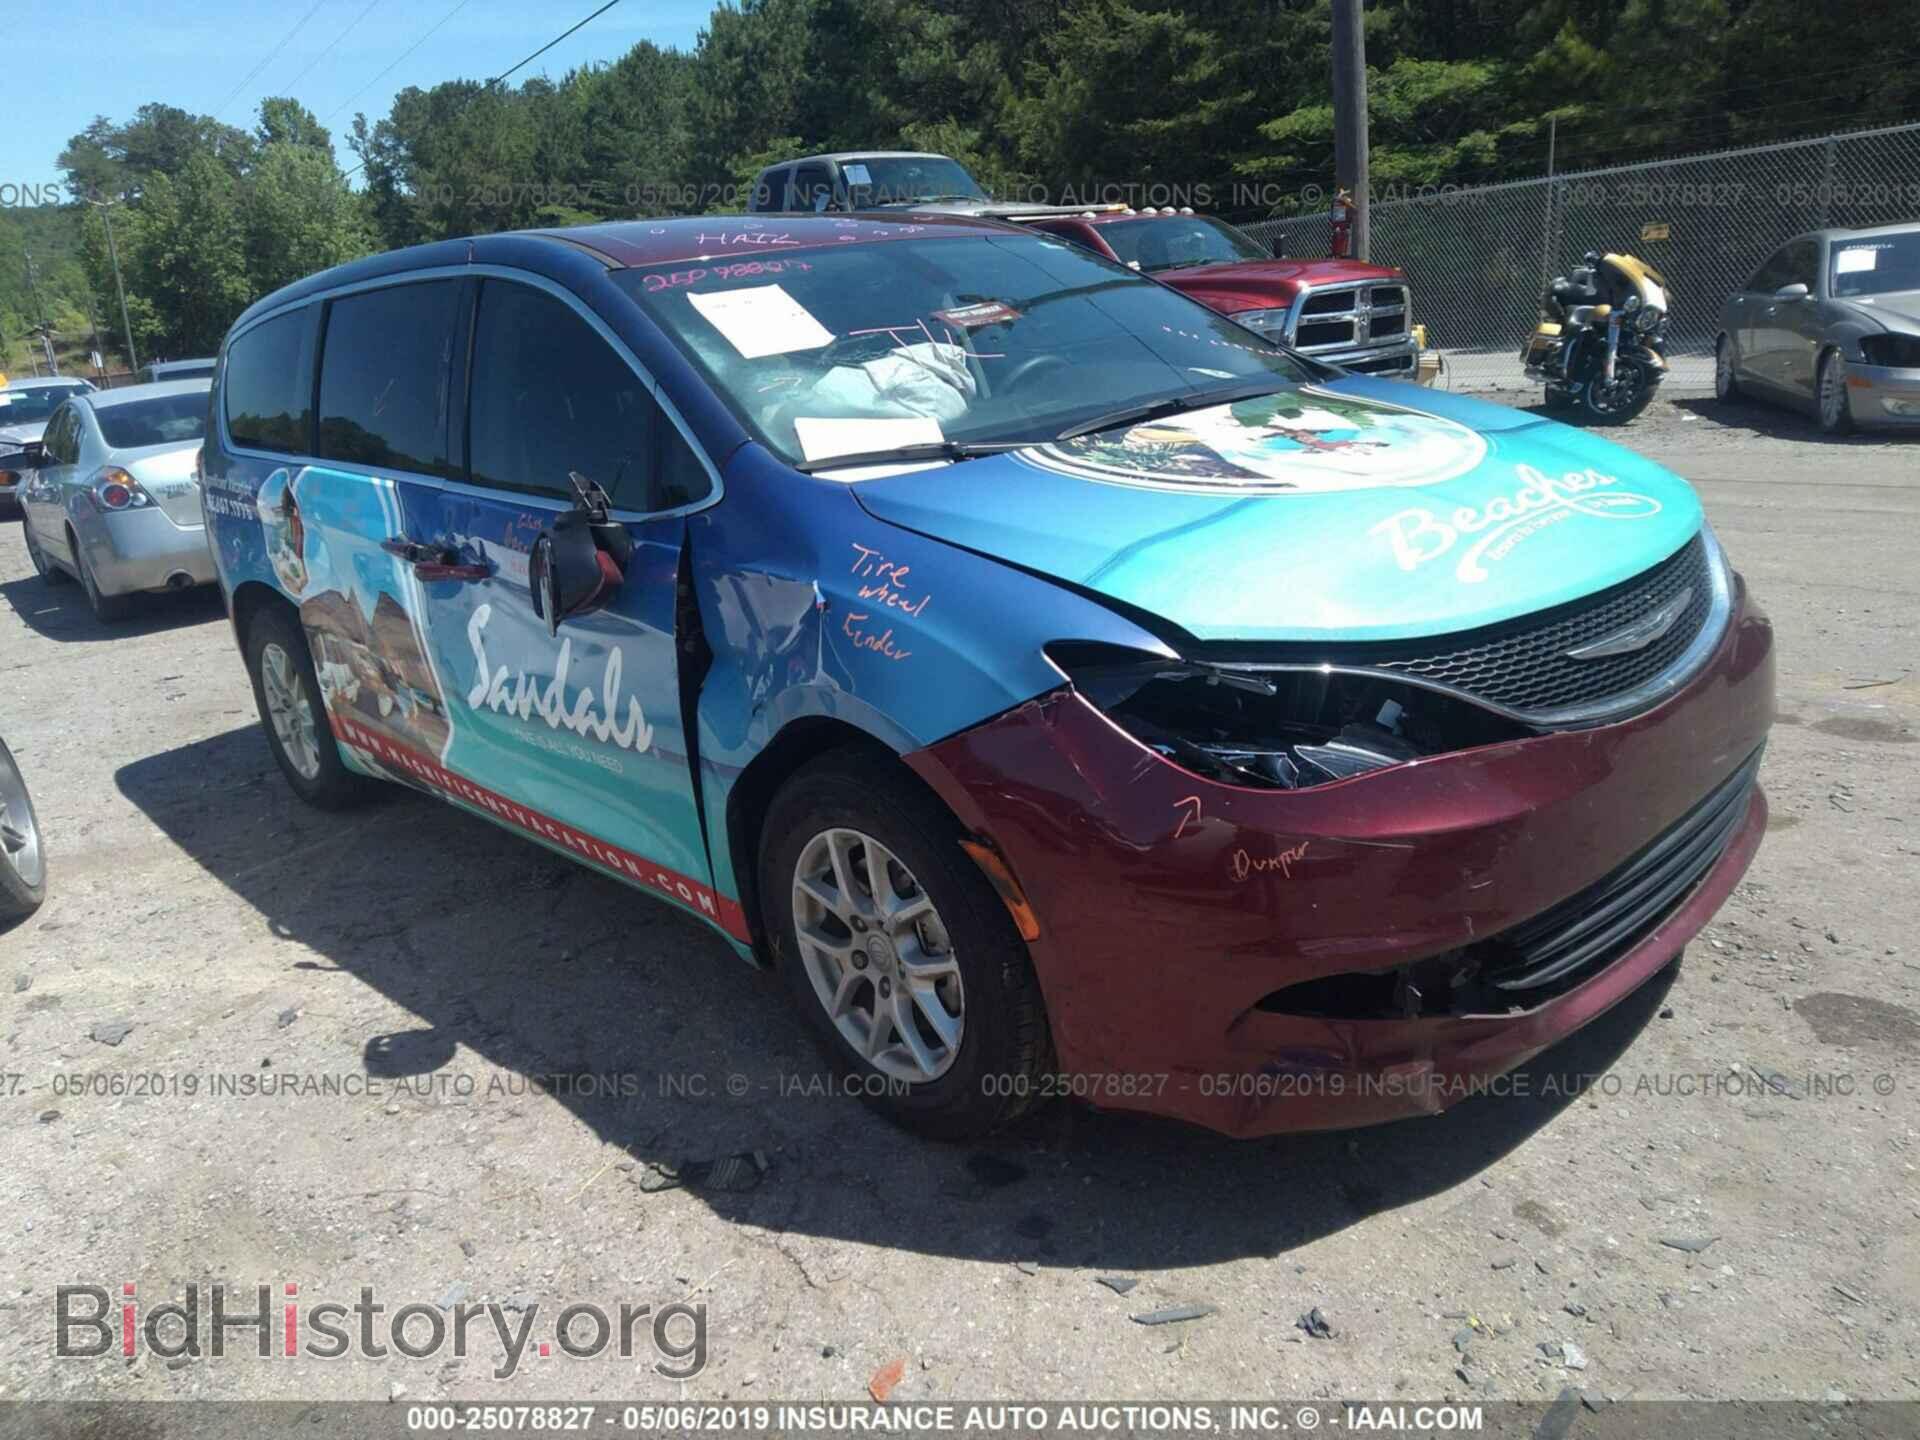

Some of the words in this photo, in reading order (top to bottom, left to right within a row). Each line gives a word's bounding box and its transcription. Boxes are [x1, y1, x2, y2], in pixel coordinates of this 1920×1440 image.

[851, 543, 910, 588] Tire
[1368, 463, 1618, 571] Beaches
[468, 604, 654, 753] Sandals
